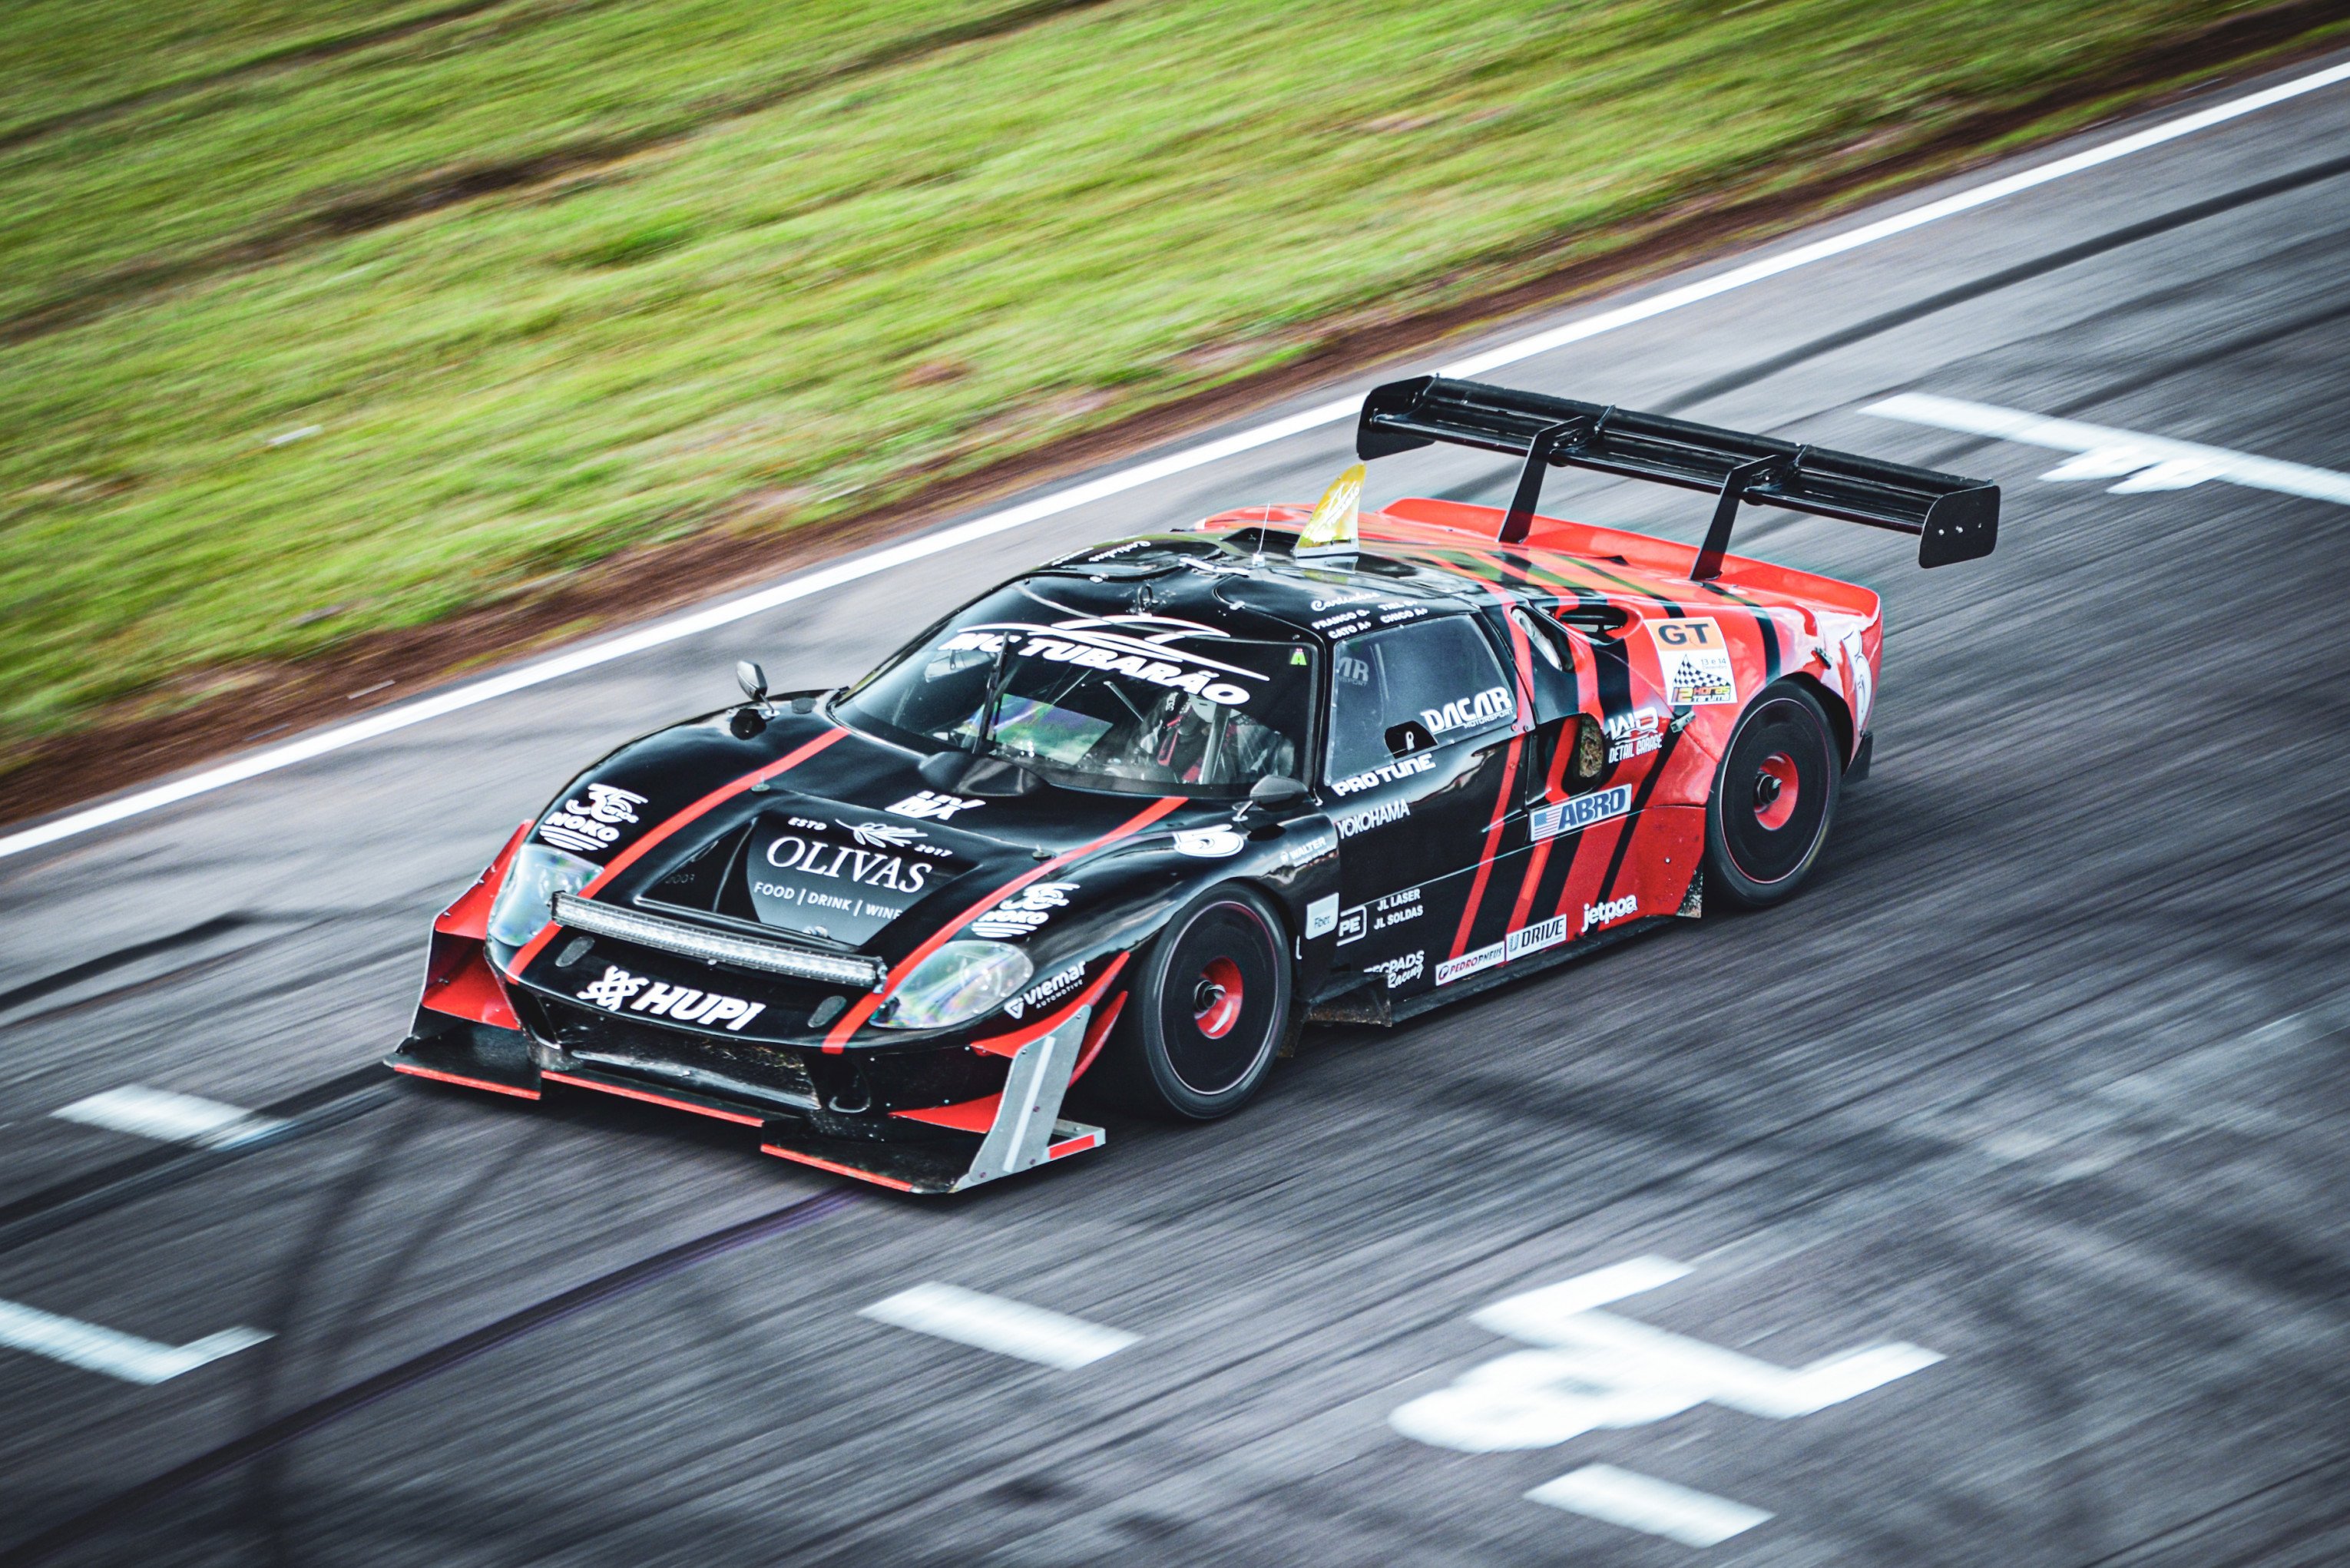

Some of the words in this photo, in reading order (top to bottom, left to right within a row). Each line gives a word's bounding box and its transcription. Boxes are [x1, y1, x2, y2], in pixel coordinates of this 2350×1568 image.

[1658, 624, 1710, 645] GT
[1018, 638, 1250, 705] TUBARÃO
[1420, 686, 1513, 731] DACAR
[1465, 708, 1513, 729] MOTORSPORT
[1332, 753, 1436, 796] PROTUNE
[788, 817, 827, 831] ESTD
[1337, 799, 1410, 839] YOKOHAMA
[1557, 789, 1626, 830] ABRO
[544, 812, 620, 841] NOKO
[915, 844, 952, 857] 2017
[1289, 836, 1326, 860] WALTER
[766, 836, 932, 893] OLIVAS
[753, 882, 795, 899] FOOD
[807, 892, 852, 911] DRINK
[1377, 898, 1389, 911] JL
[1390, 888, 1421, 907] LASER
[1374, 918, 1385, 930] JL
[1387, 905, 1423, 925] SOLDAS
[1581, 895, 1638, 933] jetpoa
[1521, 918, 1564, 948] DRIVE
[1388, 963, 1424, 989] Racing
[630, 982, 766, 1031] HUPI
[1036, 979, 1084, 1009] AUTOMOTIVE
